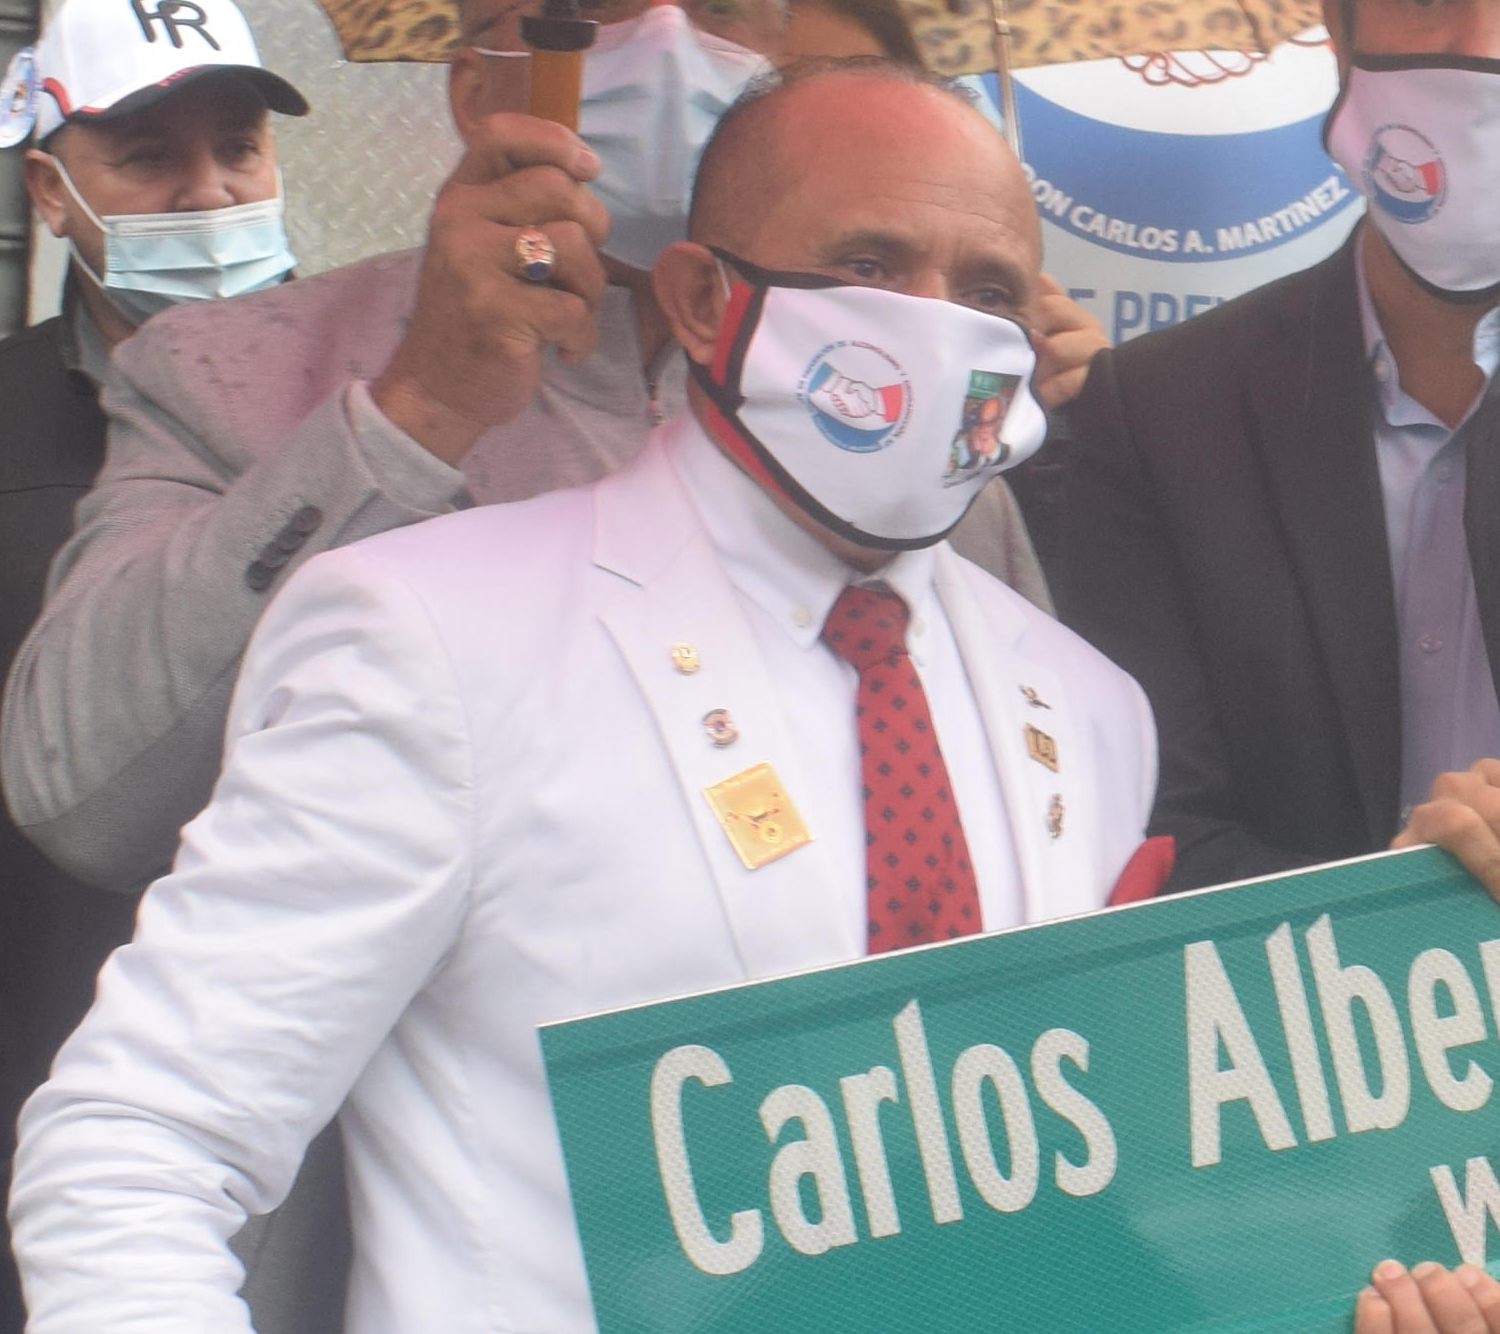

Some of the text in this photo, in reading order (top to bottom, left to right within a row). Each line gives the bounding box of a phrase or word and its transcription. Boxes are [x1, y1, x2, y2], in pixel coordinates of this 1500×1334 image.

[1069, 205, 1180, 254] CARLOS
[1184, 230, 1214, 254] A.
[650, 999, 1118, 1275] Carlos
